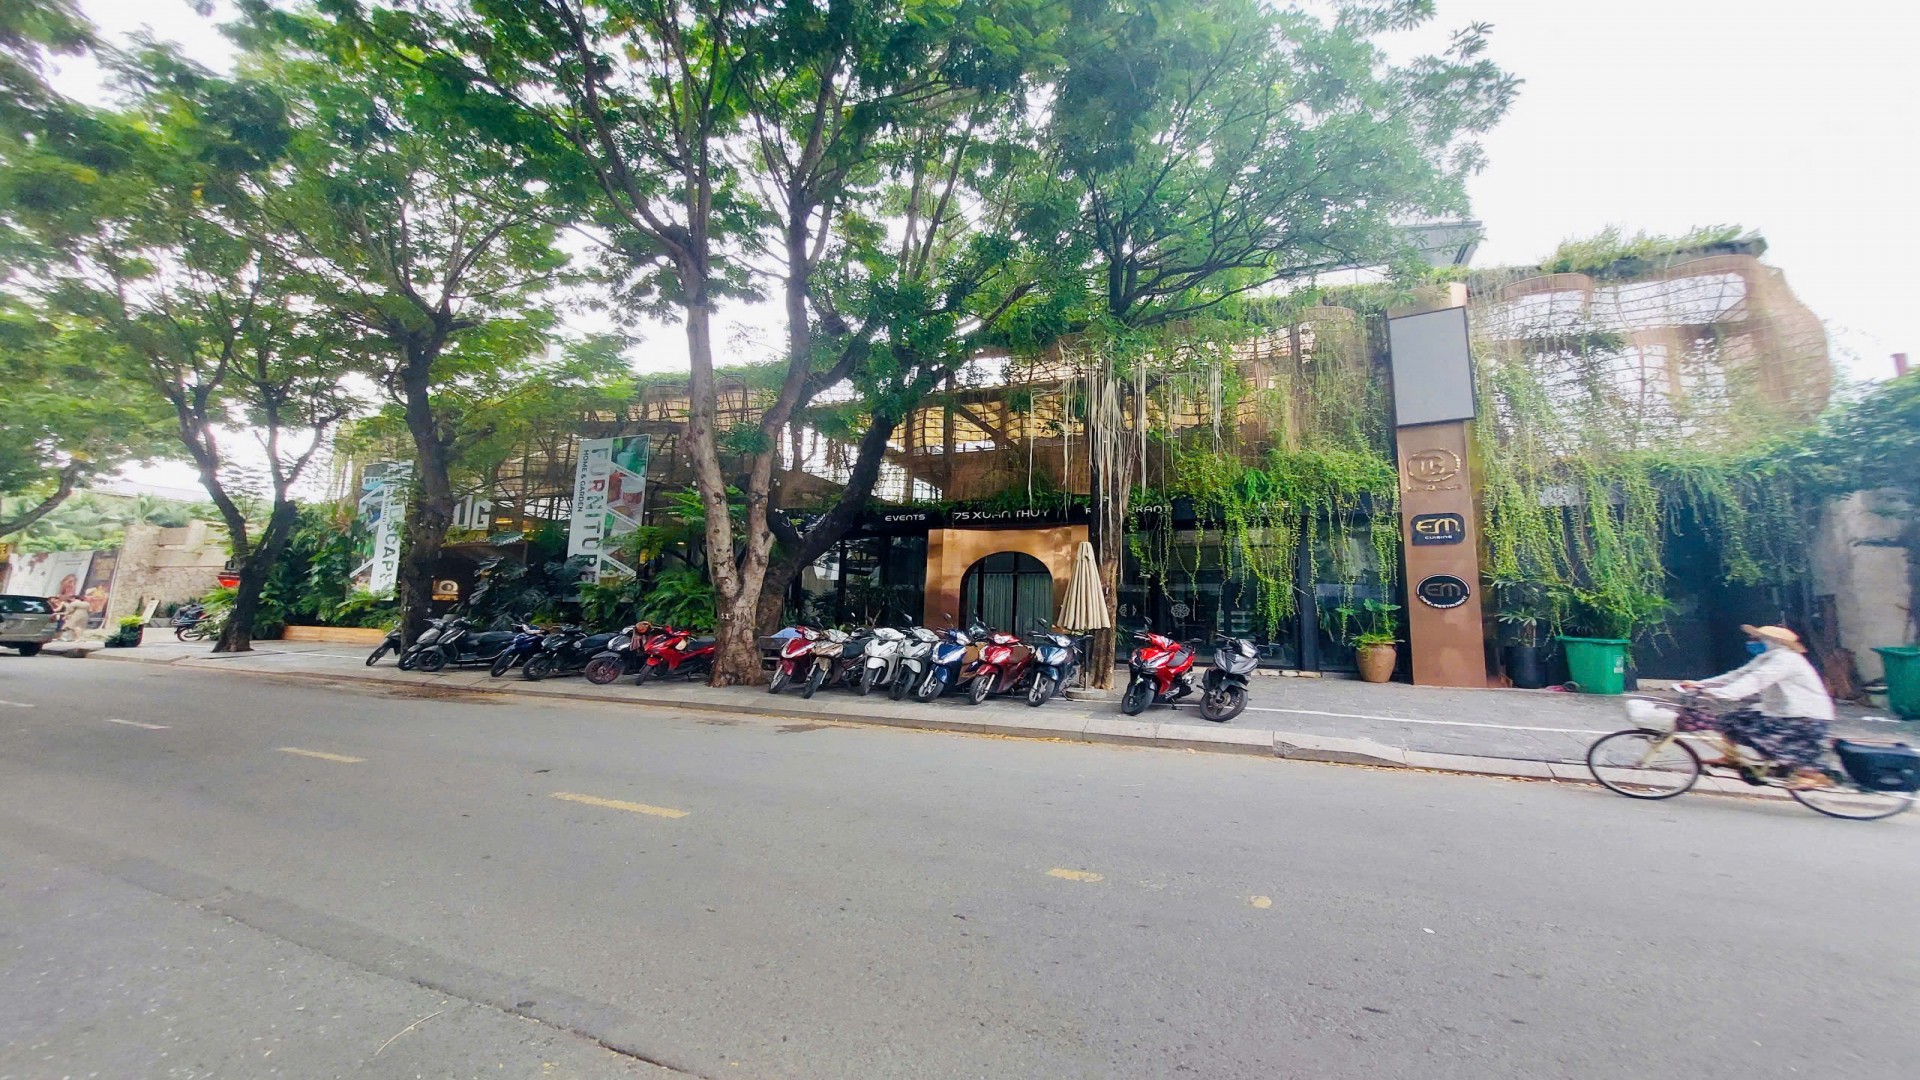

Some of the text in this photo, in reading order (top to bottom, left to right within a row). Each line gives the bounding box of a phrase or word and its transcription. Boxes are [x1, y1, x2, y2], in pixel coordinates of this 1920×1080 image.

[581, 449, 590, 472] HOME
[577, 480, 586, 512] GARDEN
[579, 447, 609, 584] FURNITURE
[885, 513, 926, 522] EVENTS
[955, 512, 970, 520] 75
